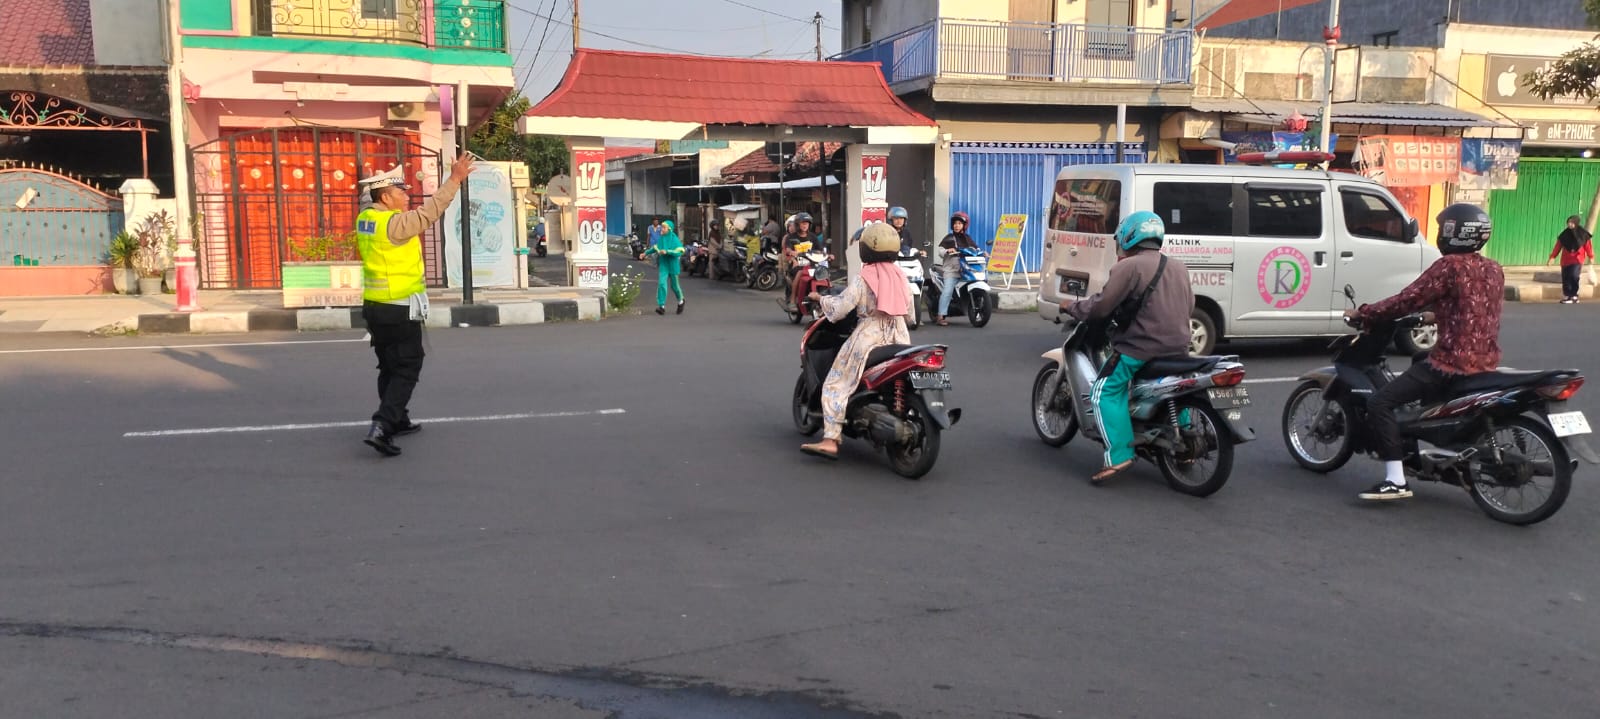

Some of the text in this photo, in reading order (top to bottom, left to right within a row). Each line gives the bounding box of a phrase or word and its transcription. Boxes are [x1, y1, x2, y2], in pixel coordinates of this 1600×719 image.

[1547, 124, 1596, 139] eM-PHONE
[579, 162, 601, 190] 17
[864, 166, 884, 192] 17
[580, 220, 604, 244] 08
[1056, 235, 1106, 248] AMBULANCE
[1168, 238, 1201, 246] KLINIK
[1191, 272, 1226, 286] ANCE
